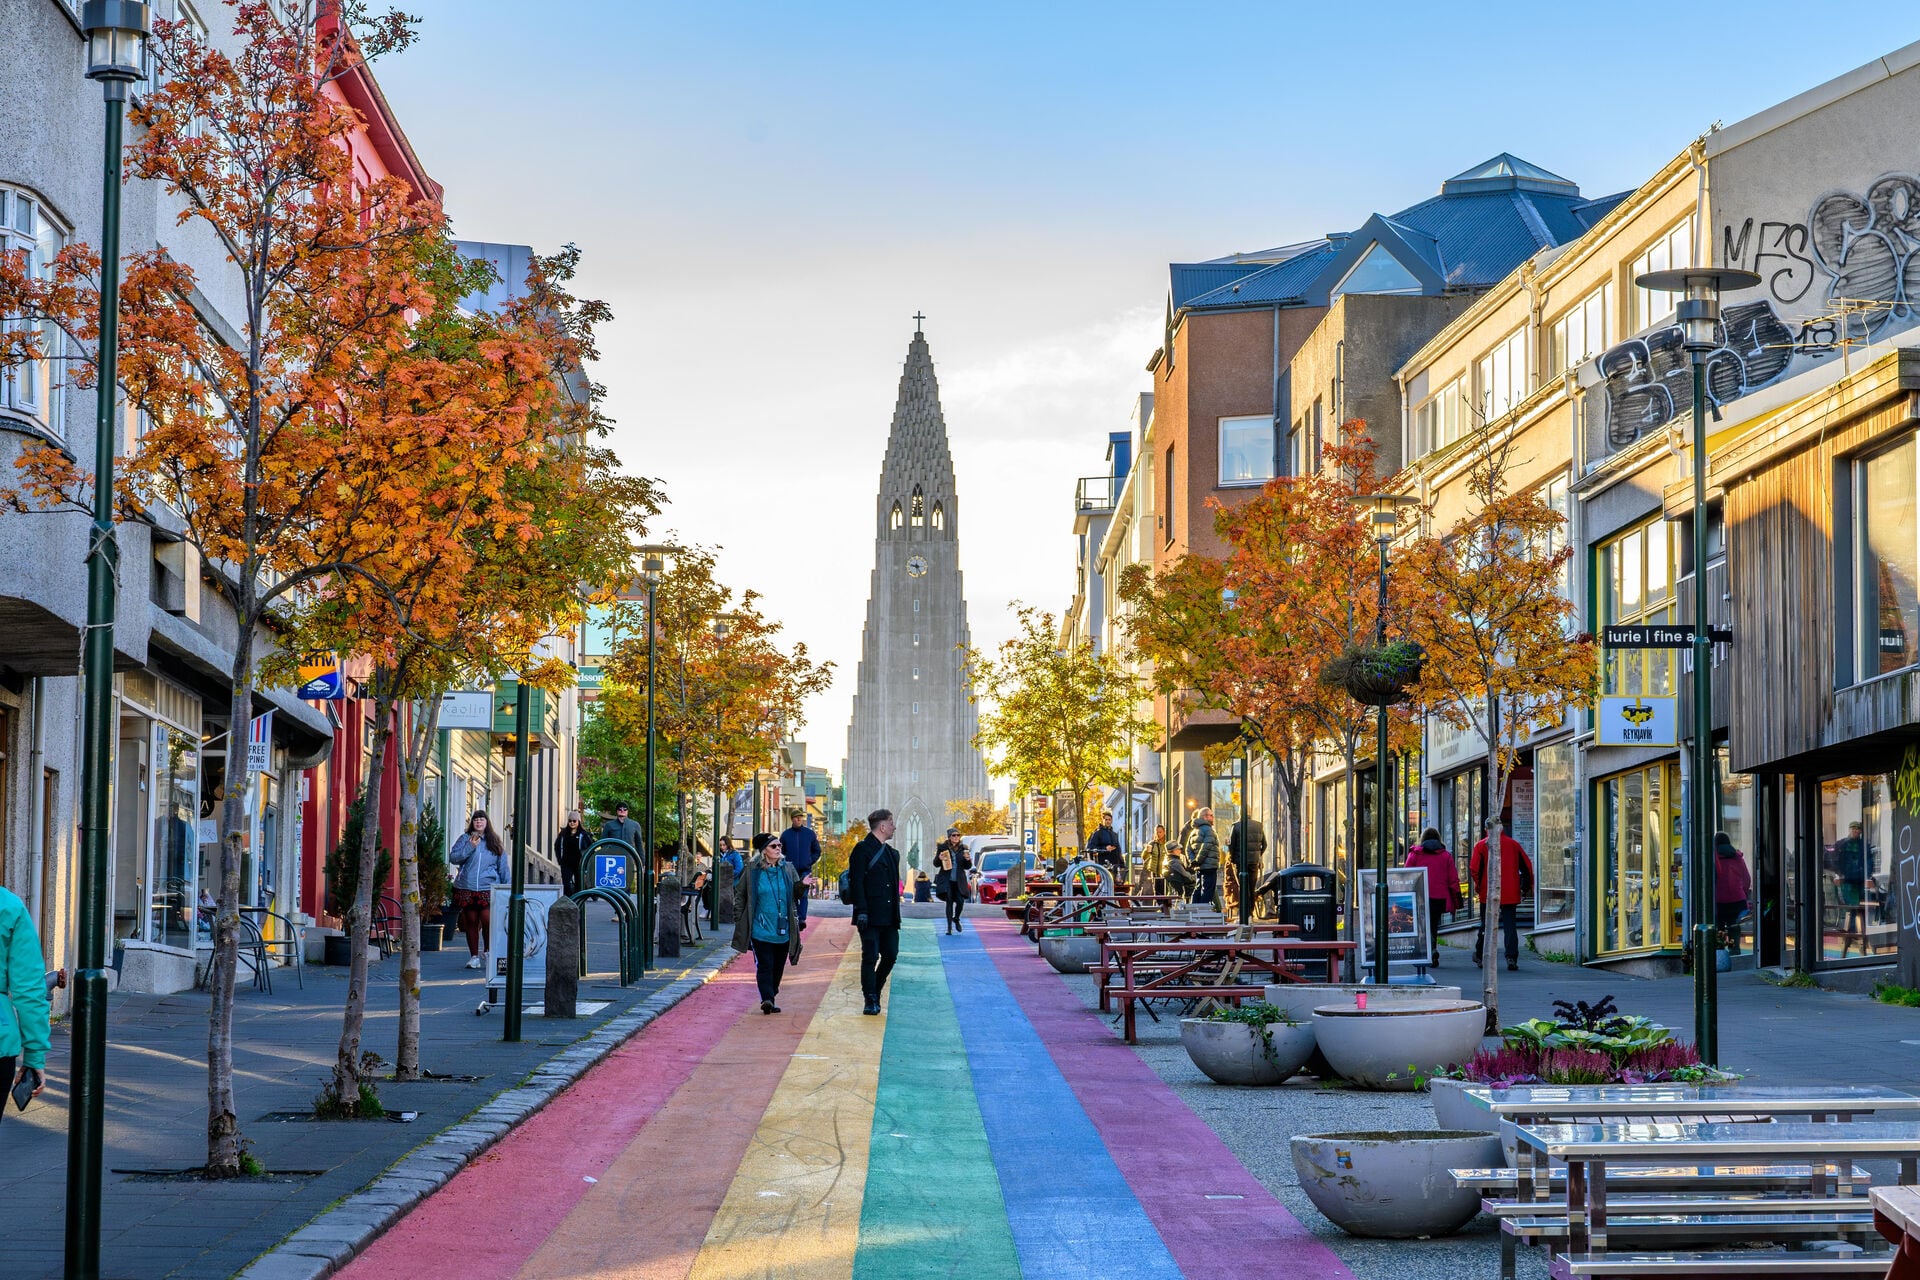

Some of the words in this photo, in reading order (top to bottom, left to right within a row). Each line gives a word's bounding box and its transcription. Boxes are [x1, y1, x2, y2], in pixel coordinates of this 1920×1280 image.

[1608, 630, 1641, 642] iurie
[1654, 630, 1682, 642] fine
[578, 672, 604, 681] dsson
[443, 703, 485, 714] Kaolin
[248, 745, 265, 754] FREE
[605, 857, 616, 873] P
